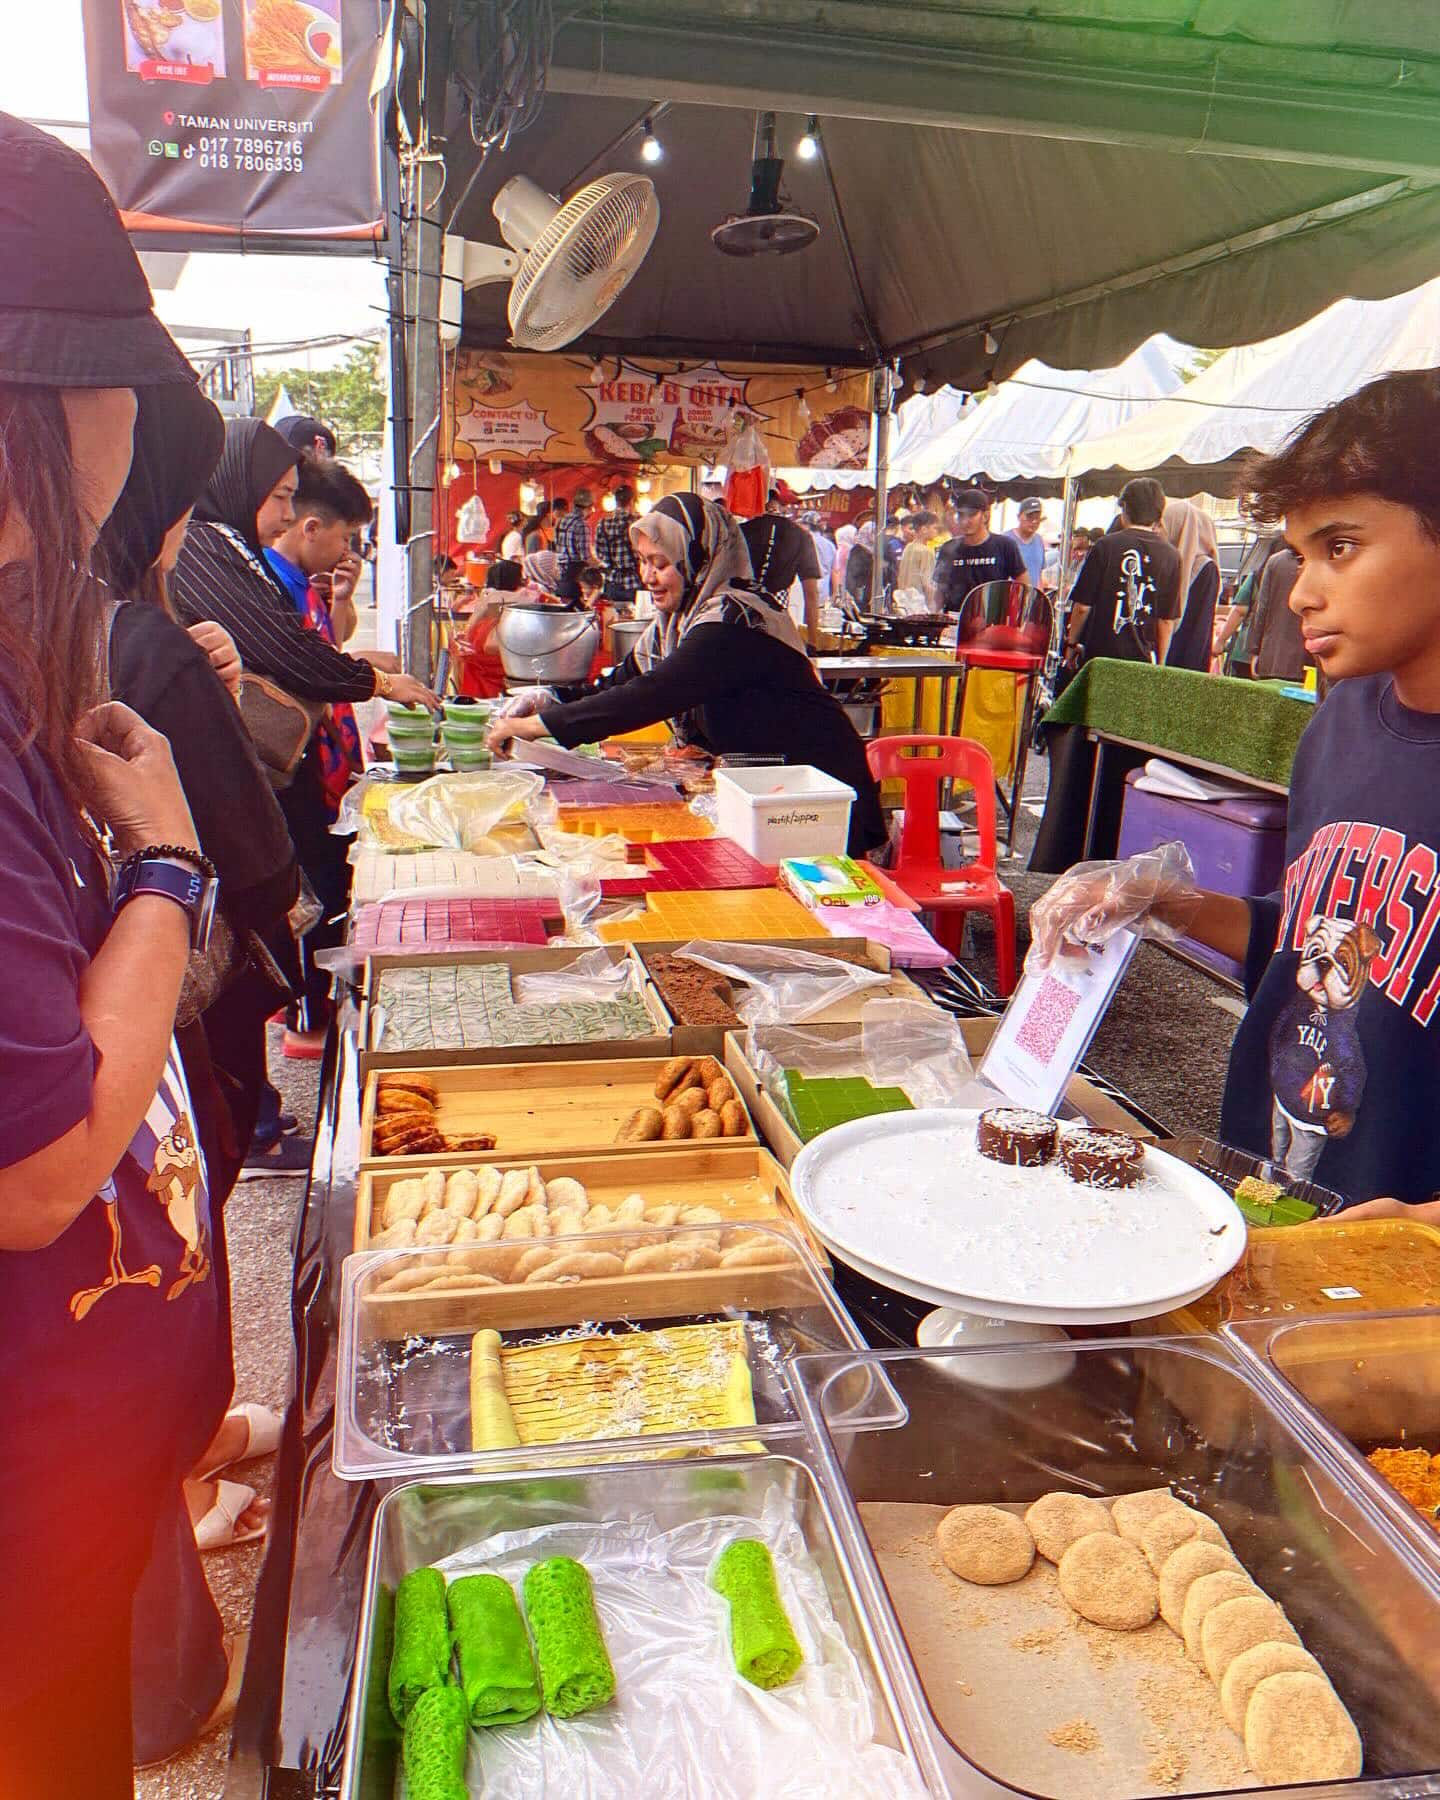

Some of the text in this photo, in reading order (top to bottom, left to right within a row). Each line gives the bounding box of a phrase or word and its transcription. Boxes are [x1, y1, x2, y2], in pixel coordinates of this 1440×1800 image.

[178, 115, 313, 133] TAMAN UNIVERSITI
[200, 137, 303, 155] 017 7896716
[200, 153, 303, 172] 018 7806339
[472, 410, 520, 419] CONTACT
